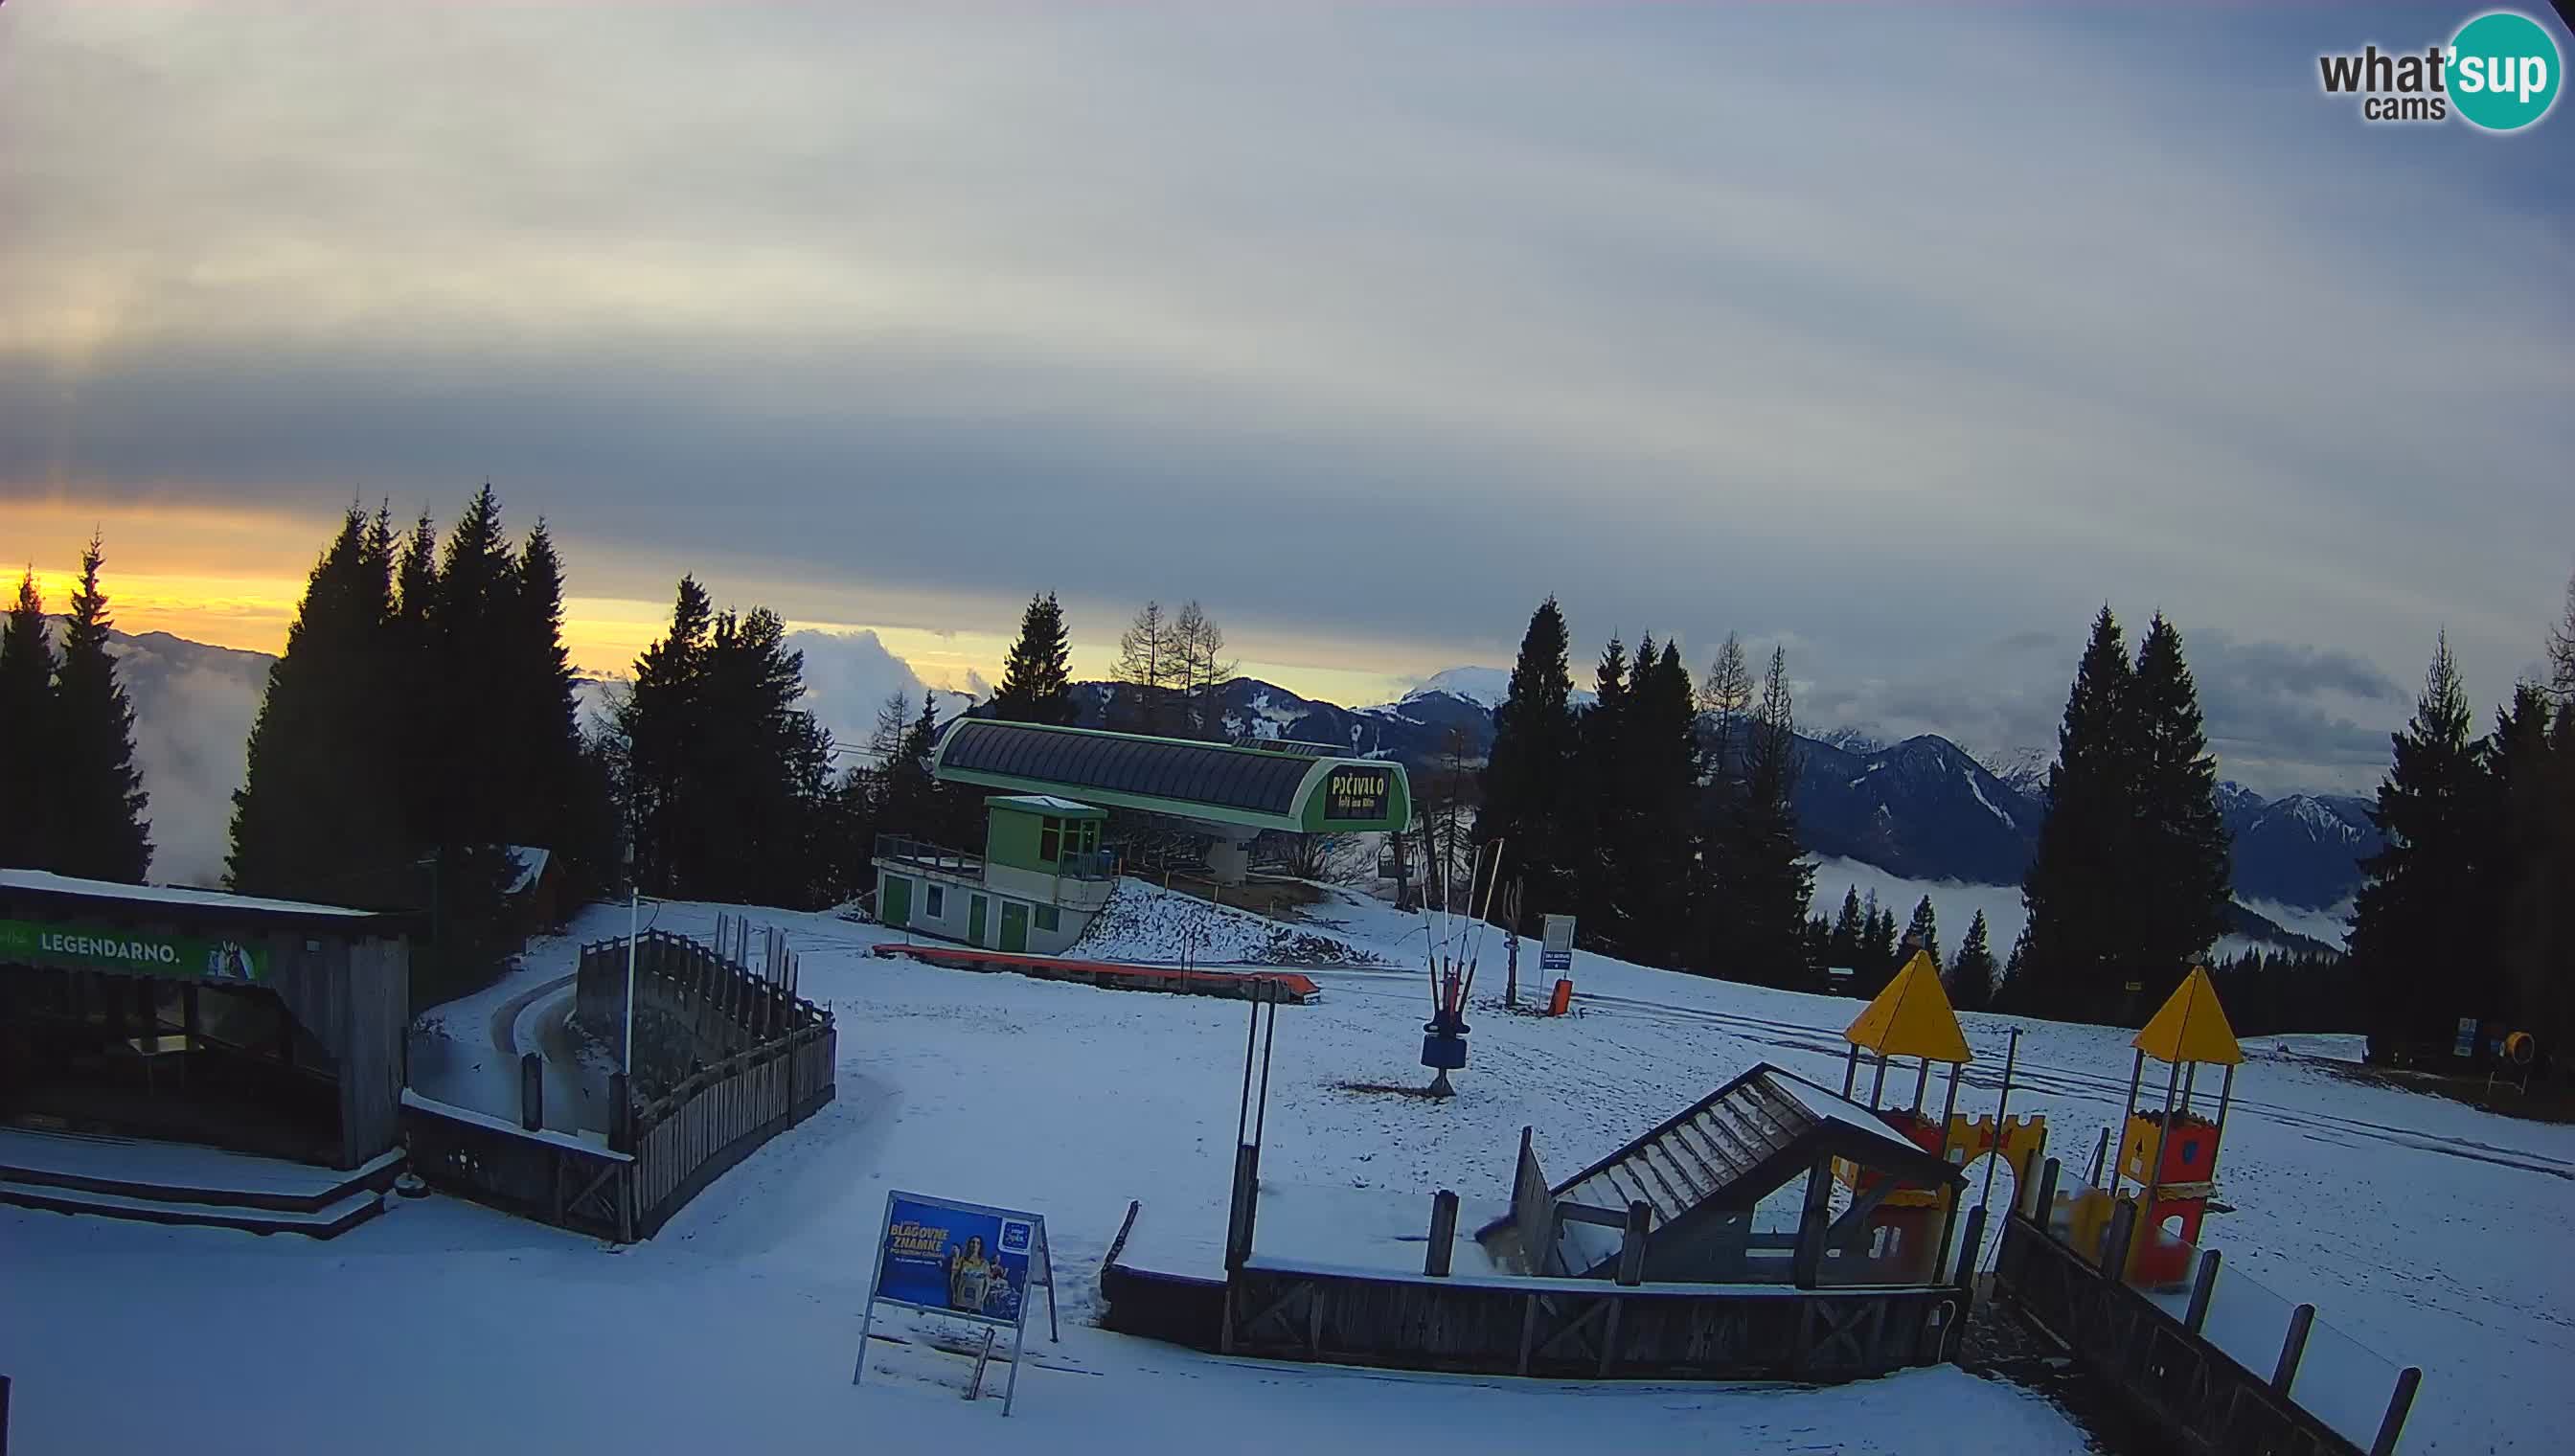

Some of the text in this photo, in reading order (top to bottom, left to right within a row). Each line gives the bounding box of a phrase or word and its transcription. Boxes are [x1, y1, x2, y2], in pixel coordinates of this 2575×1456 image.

[41, 933, 180, 964] LEGENDARNO.
[890, 1224, 949, 1240] BLAGOVNE
[893, 1237, 944, 1252] ZNAMKE
